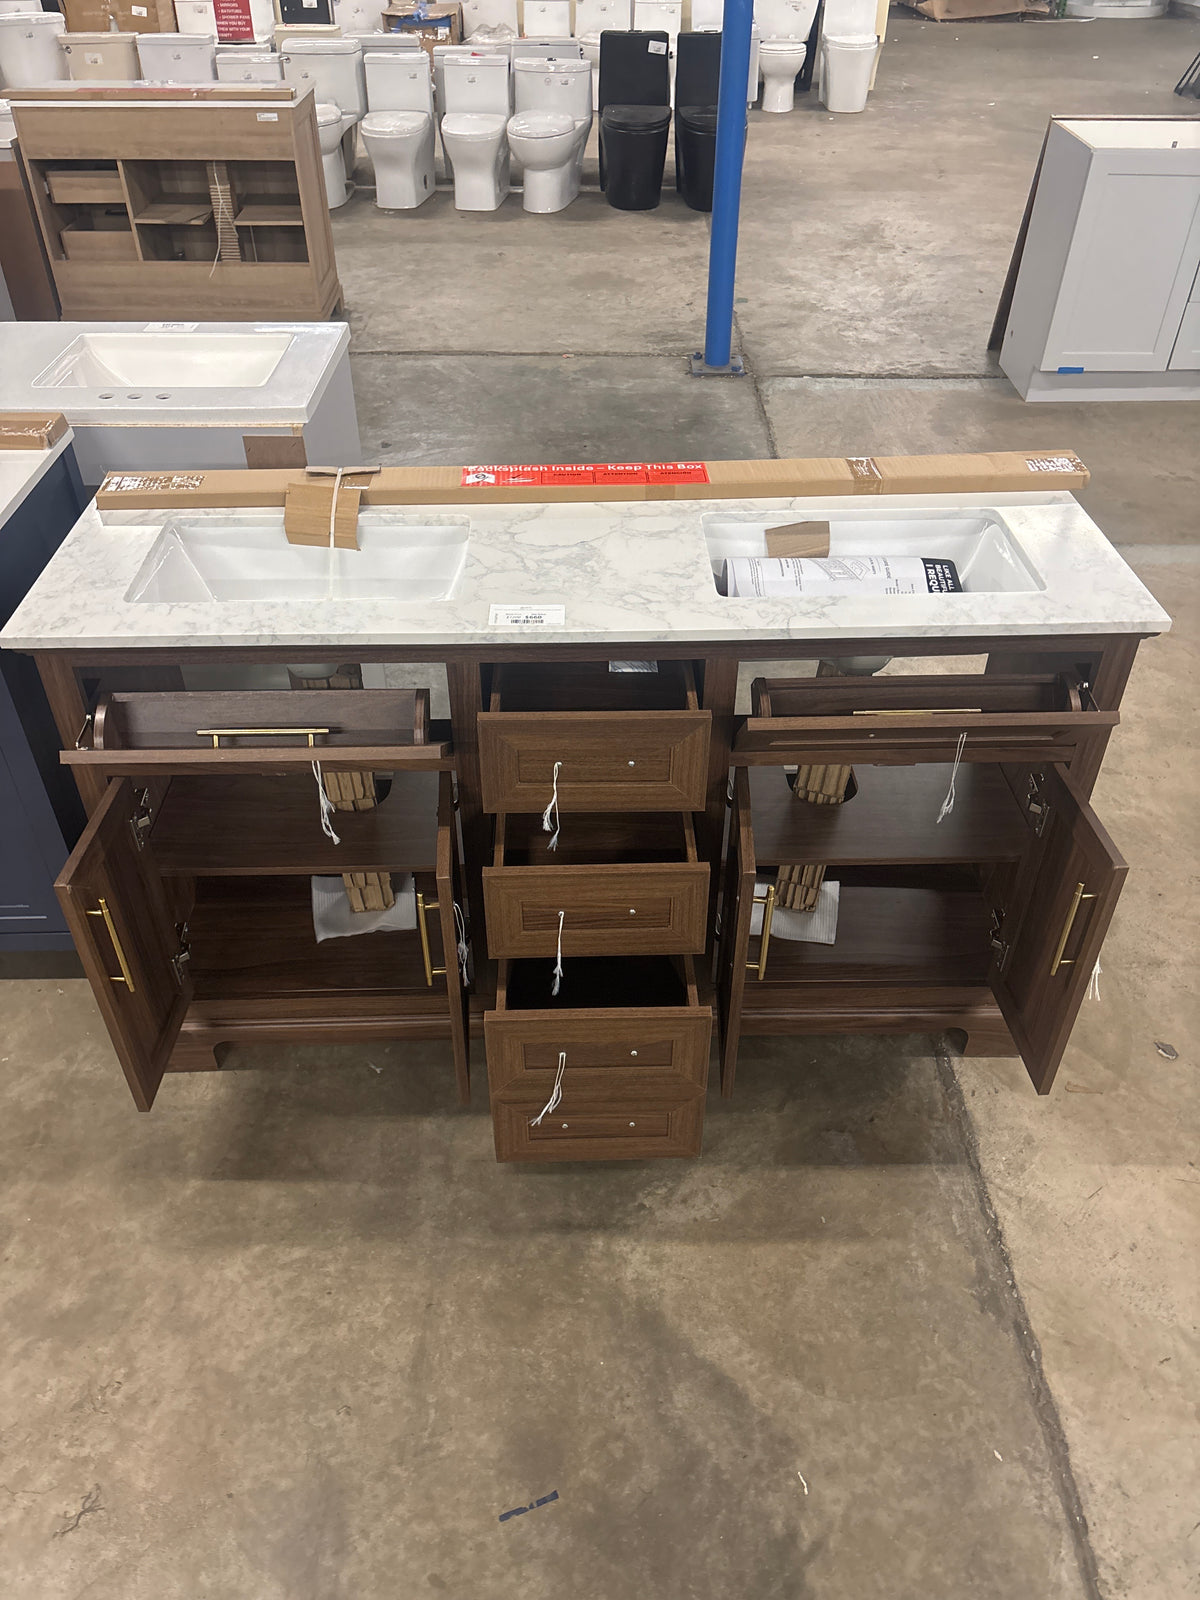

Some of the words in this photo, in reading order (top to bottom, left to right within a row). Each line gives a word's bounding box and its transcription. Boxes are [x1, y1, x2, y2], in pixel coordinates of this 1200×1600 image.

[467, 464, 548, 473] Backsplash
[551, 464, 594, 472] Inside
[607, 464, 642, 472] Keep
[645, 463, 674, 471] This
[942, 564, 951, 578] LIKE
[926, 568, 941, 593] REQU
[946, 577, 955, 591] ALL
